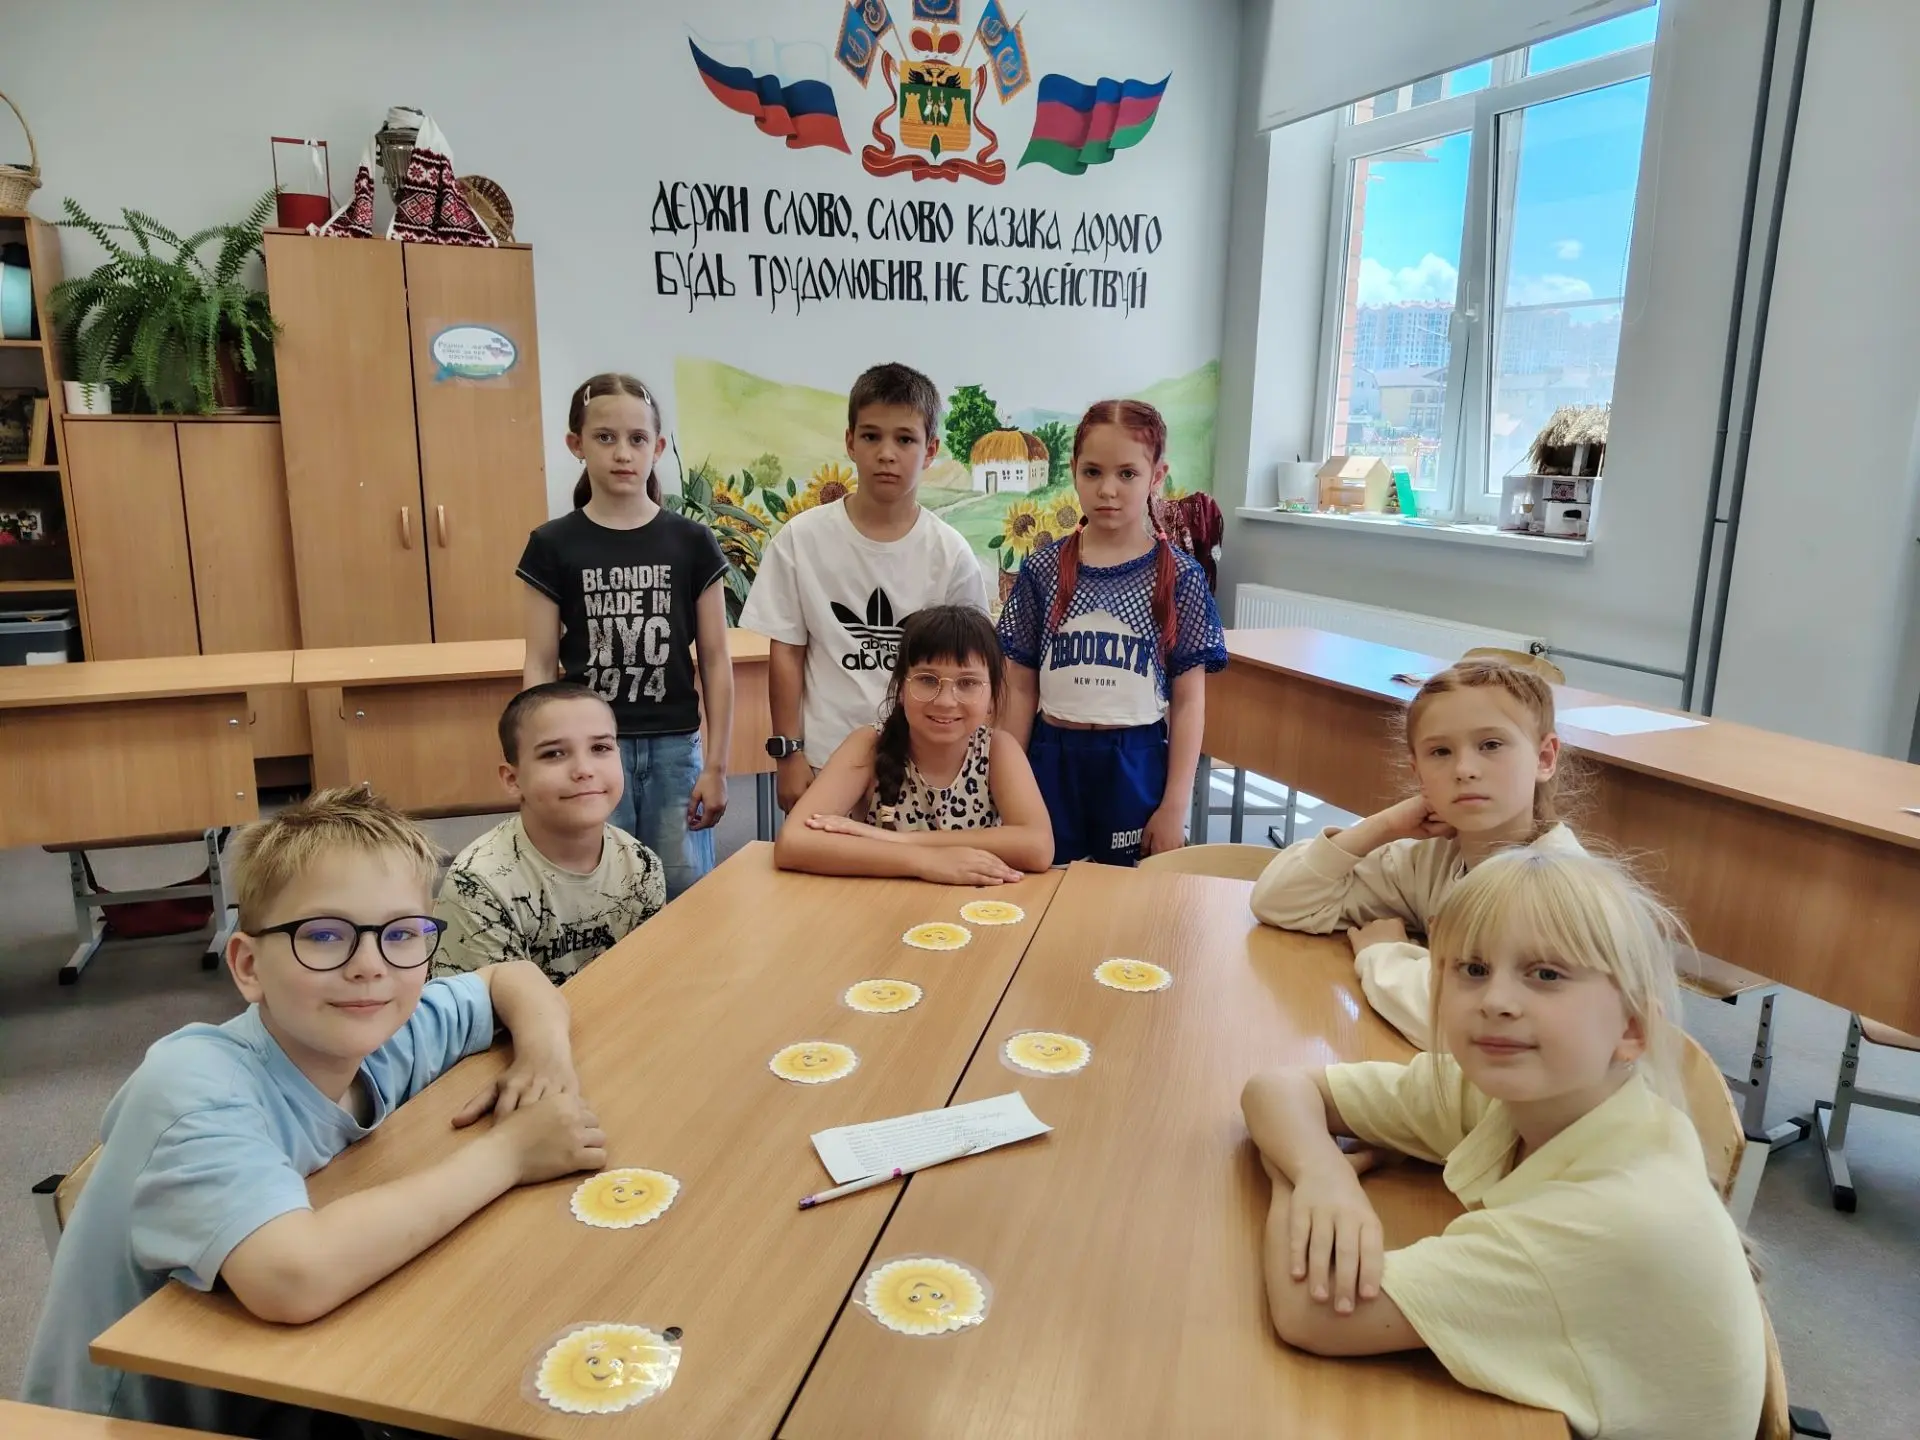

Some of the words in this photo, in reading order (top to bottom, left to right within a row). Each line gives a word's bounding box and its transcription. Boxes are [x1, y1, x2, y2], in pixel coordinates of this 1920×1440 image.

[650, 180, 749, 249] ДЕРЖИ
[764, 189, 858, 243] СЛОВО,
[867, 198, 954, 243] СЛОВО
[655, 251, 736, 313] БУДЬ
[749, 254, 928, 316] ТРУДОЛЮБИВ,
[935, 261, 970, 302] НЕ
[982, 262, 1147, 319] БЕЗДЕЙСТВУЙ
[582, 564, 672, 593] BLONDIE
[584, 590, 644, 617] MADE
[652, 590, 671, 615] IN
[586, 615, 671, 668] NYC
[583, 667, 667, 703] 1974
[1074, 677, 1091, 686] NEW
[1095, 678, 1117, 687] YORK
